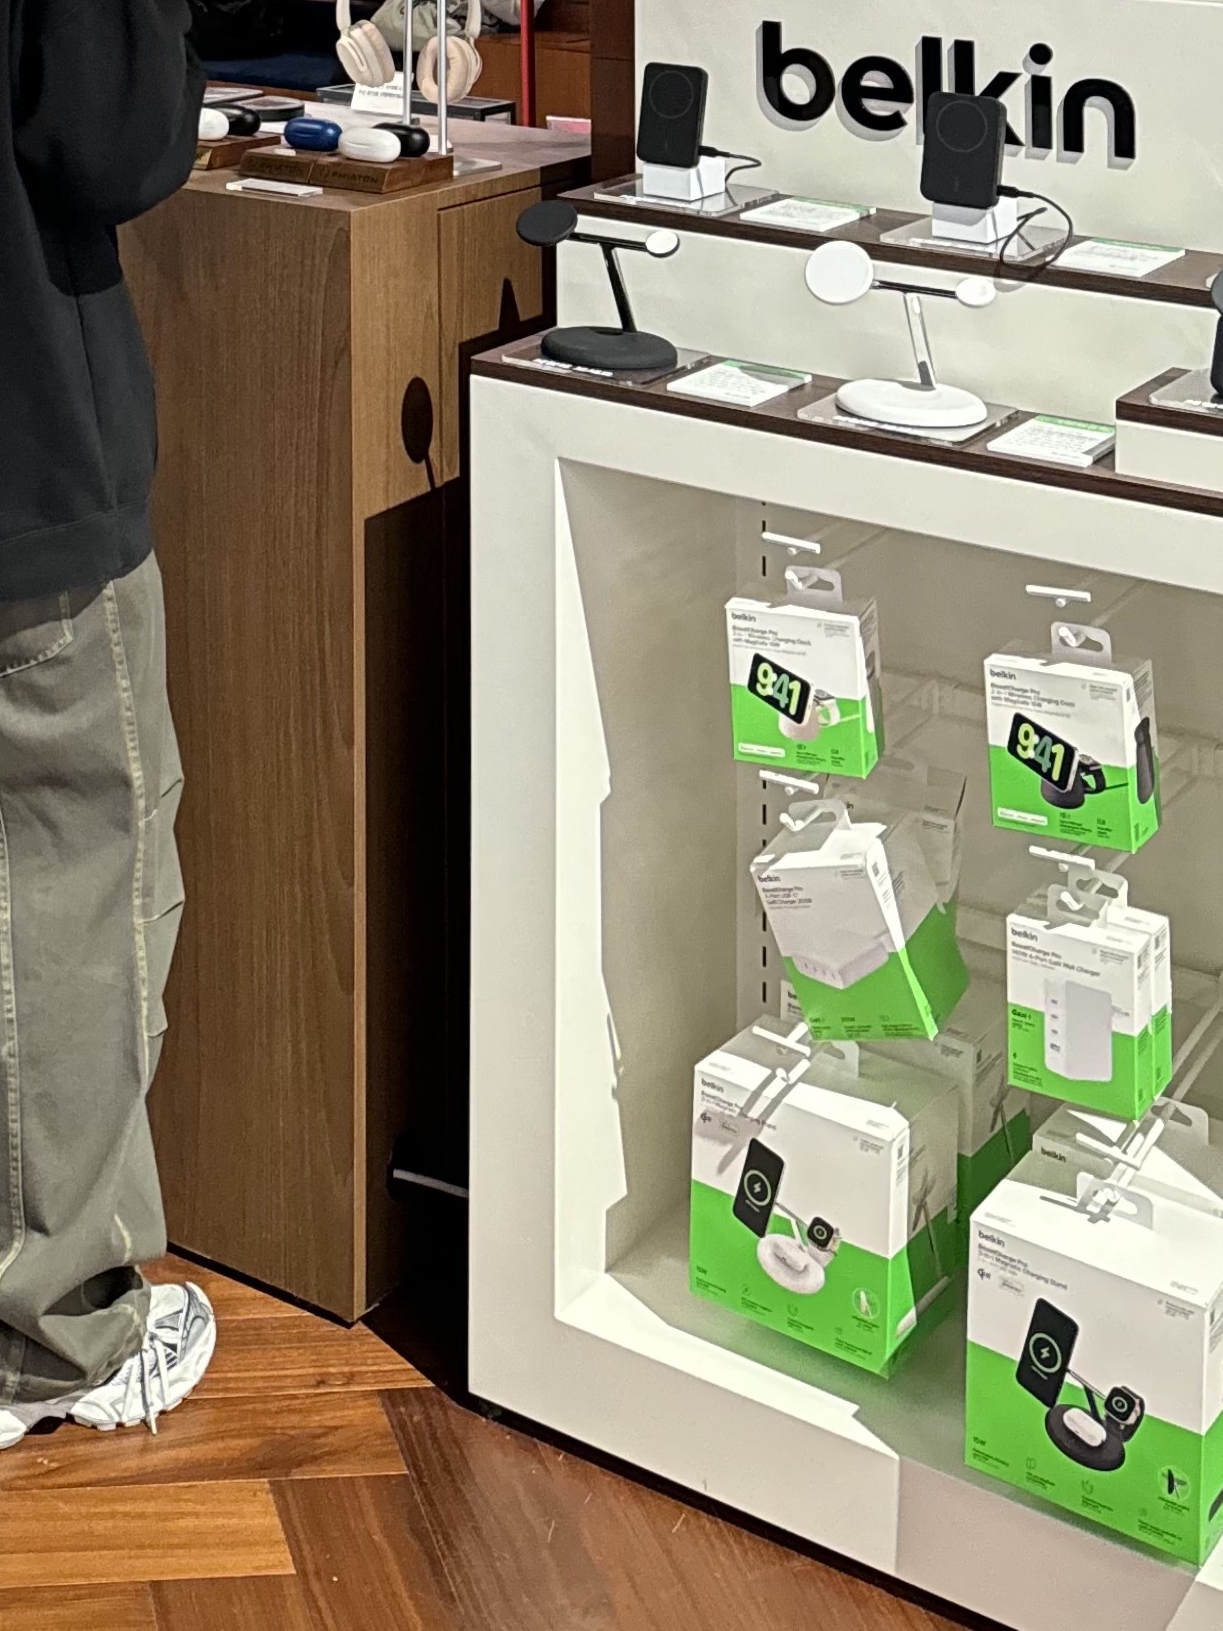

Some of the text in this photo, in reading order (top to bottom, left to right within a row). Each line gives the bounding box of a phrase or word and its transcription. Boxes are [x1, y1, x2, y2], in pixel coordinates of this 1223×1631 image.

[758, 20, 1136, 167] belkin
[731, 611, 756, 623] belkin
[989, 668, 1017, 681] belkin
[1011, 927, 1038, 943] belkin
[701, 1077, 725, 1094] belkin
[1039, 1145, 1068, 1164] belkin
[978, 1229, 1006, 1249] belkin
